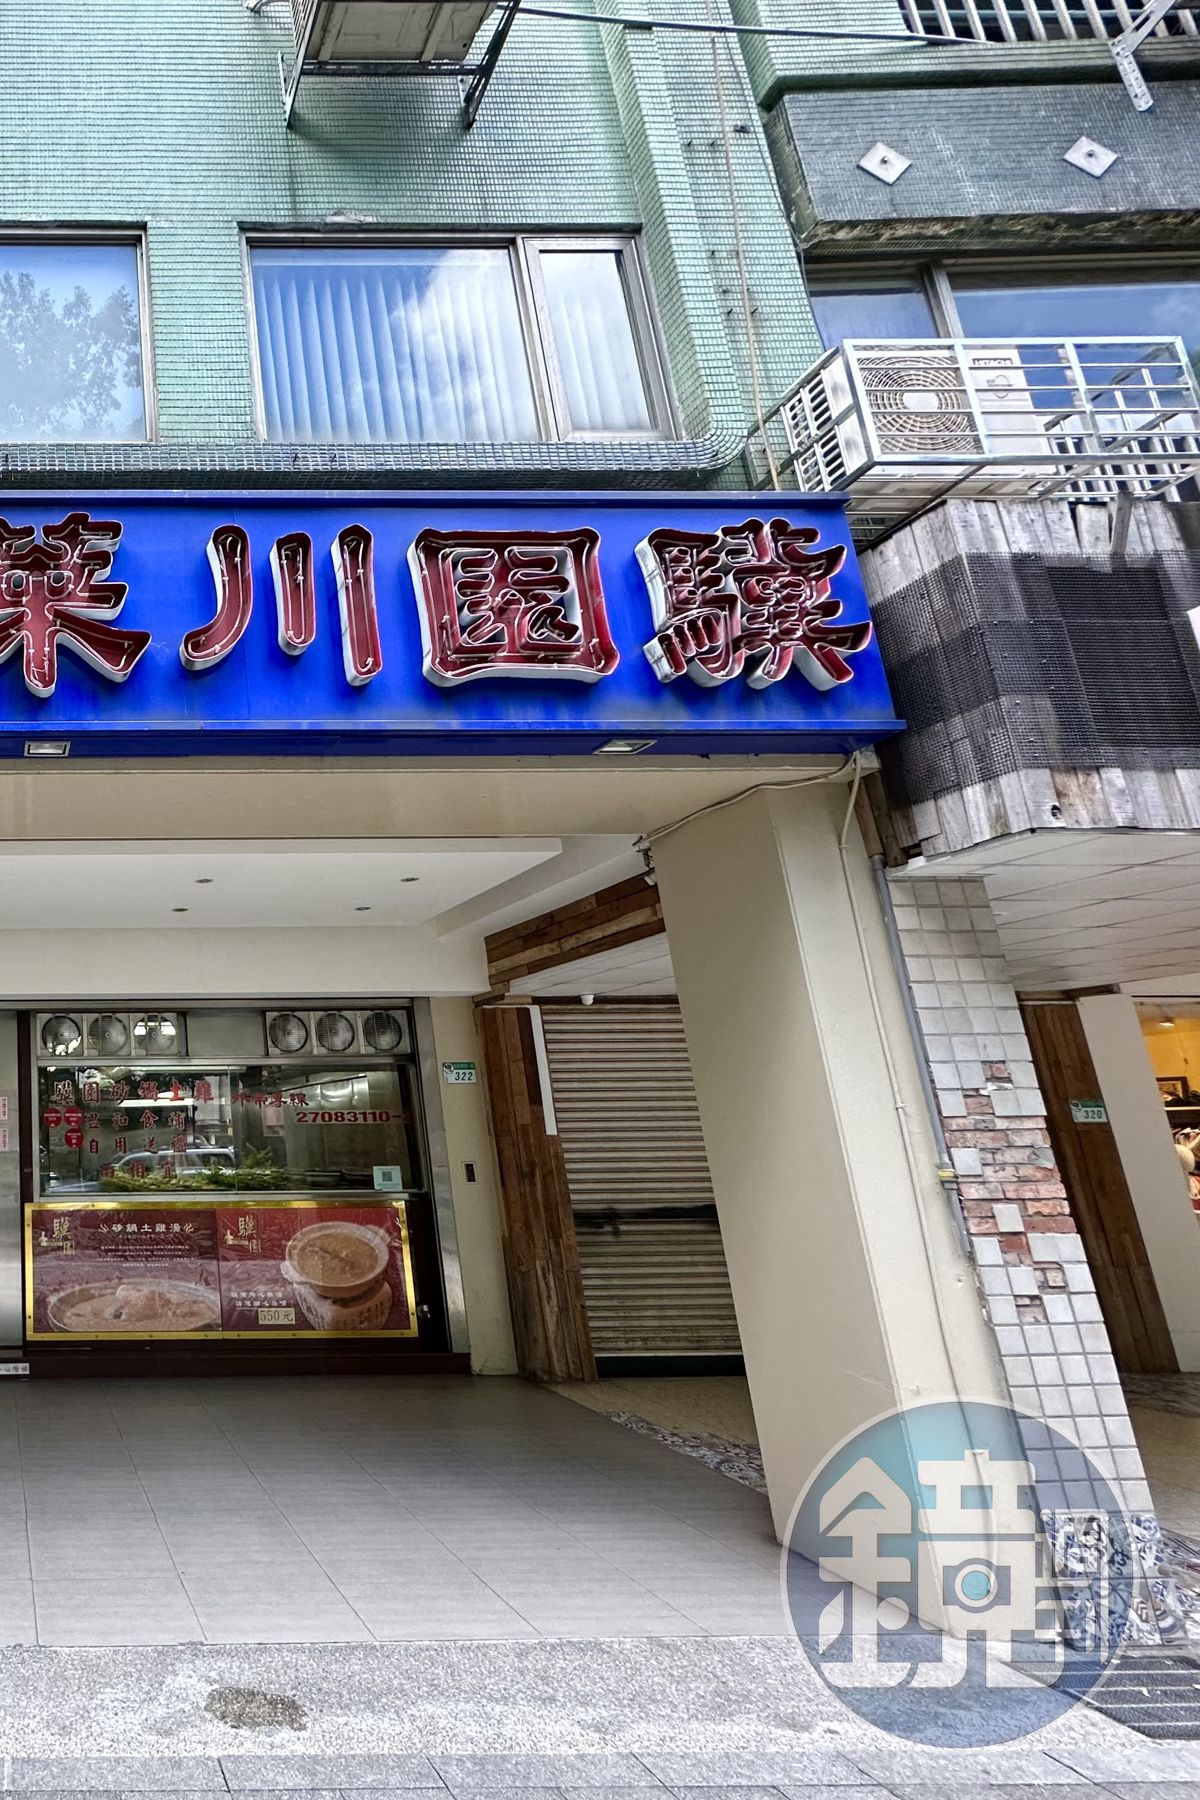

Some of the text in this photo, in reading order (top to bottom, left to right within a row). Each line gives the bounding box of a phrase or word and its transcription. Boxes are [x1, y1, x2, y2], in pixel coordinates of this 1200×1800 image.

[454, 1071, 473, 1081] 322
[1083, 1109, 1103, 1120] 320
[110, 1222, 182, 1234] 砂鍋土雞湯
[260, 1310, 294, 1322] 550元
